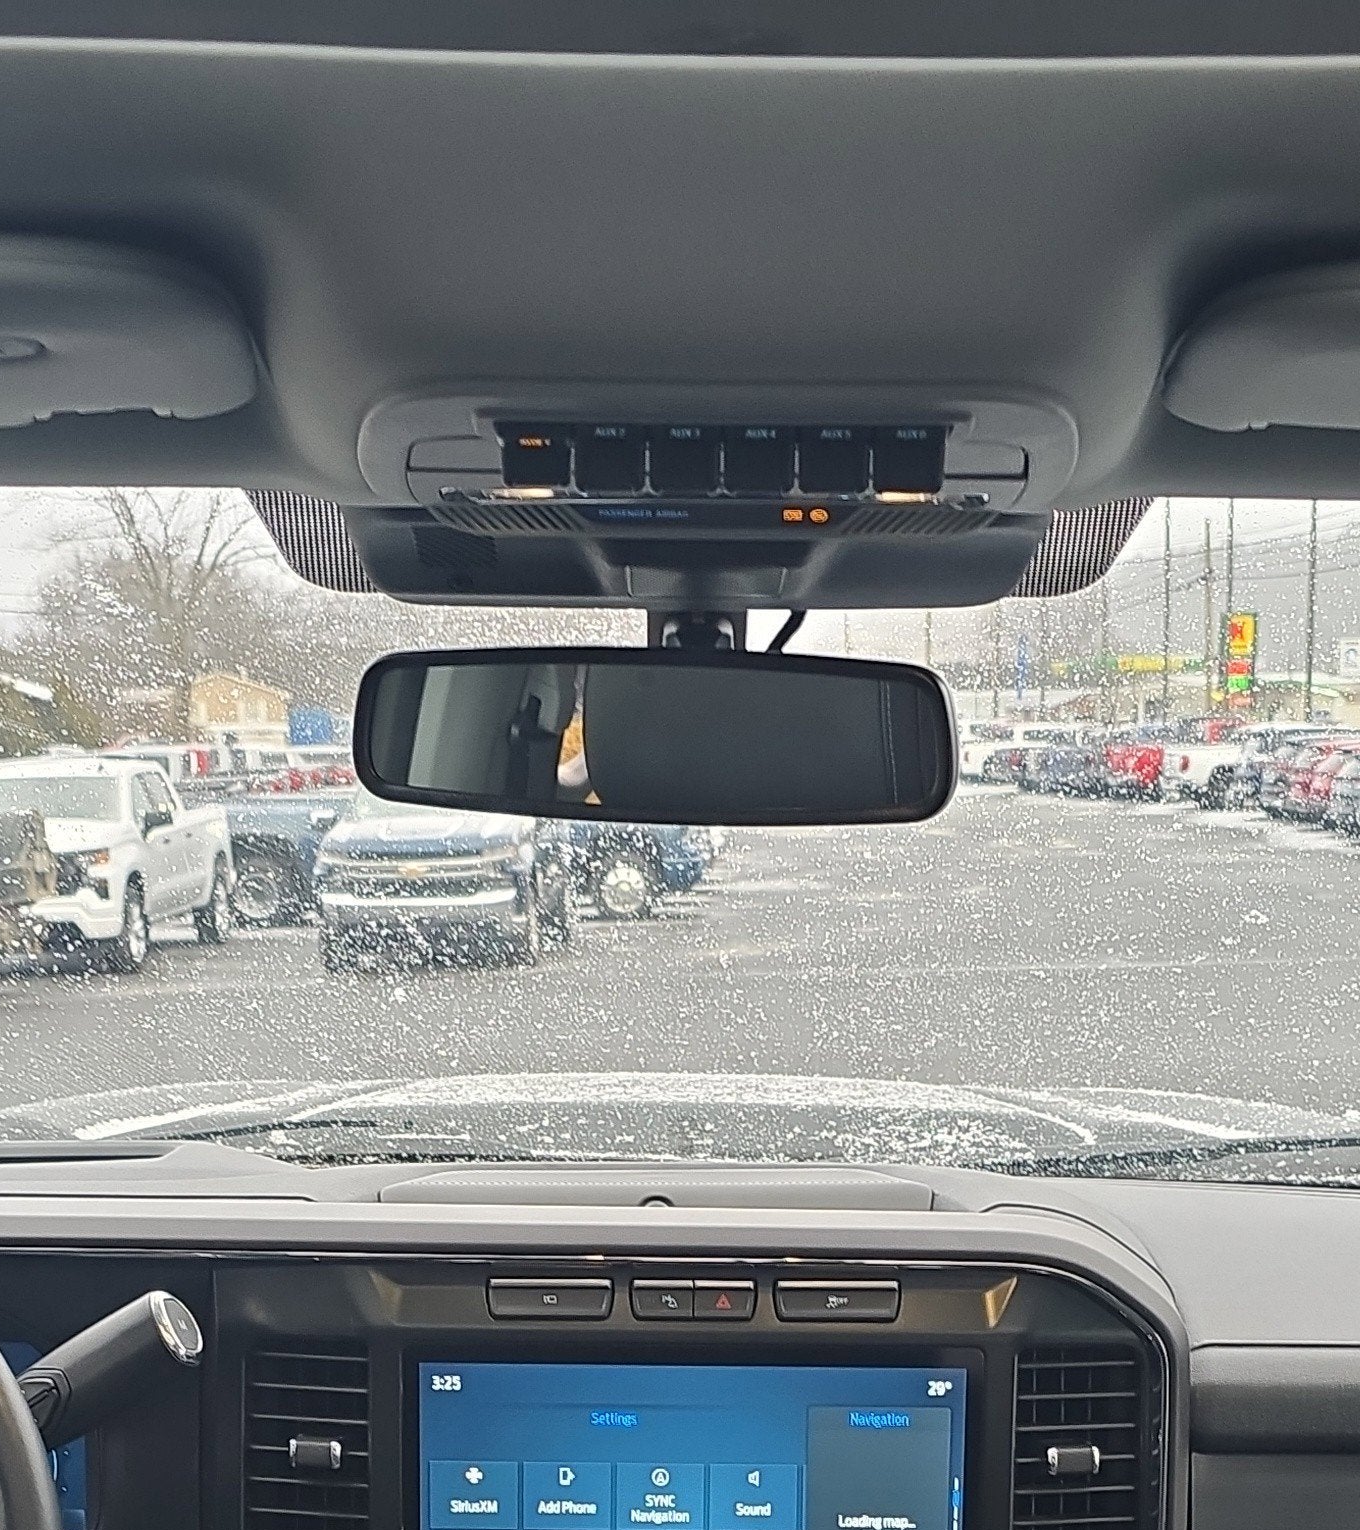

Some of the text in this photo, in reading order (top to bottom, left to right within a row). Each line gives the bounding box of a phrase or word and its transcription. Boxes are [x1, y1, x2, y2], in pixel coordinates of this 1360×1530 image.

[431, 1375, 461, 1391] 3:25
[590, 1412, 638, 1428] Settings
[848, 1411, 909, 1429] Navigation
[449, 1499, 498, 1514] SiriusXM
[538, 1500, 597, 1515] Add Phone
[644, 1493, 676, 1508] SYNC
[630, 1508, 690, 1525] Navigation
[735, 1502, 772, 1517] Sound
[837, 1514, 882, 1530] Loading
